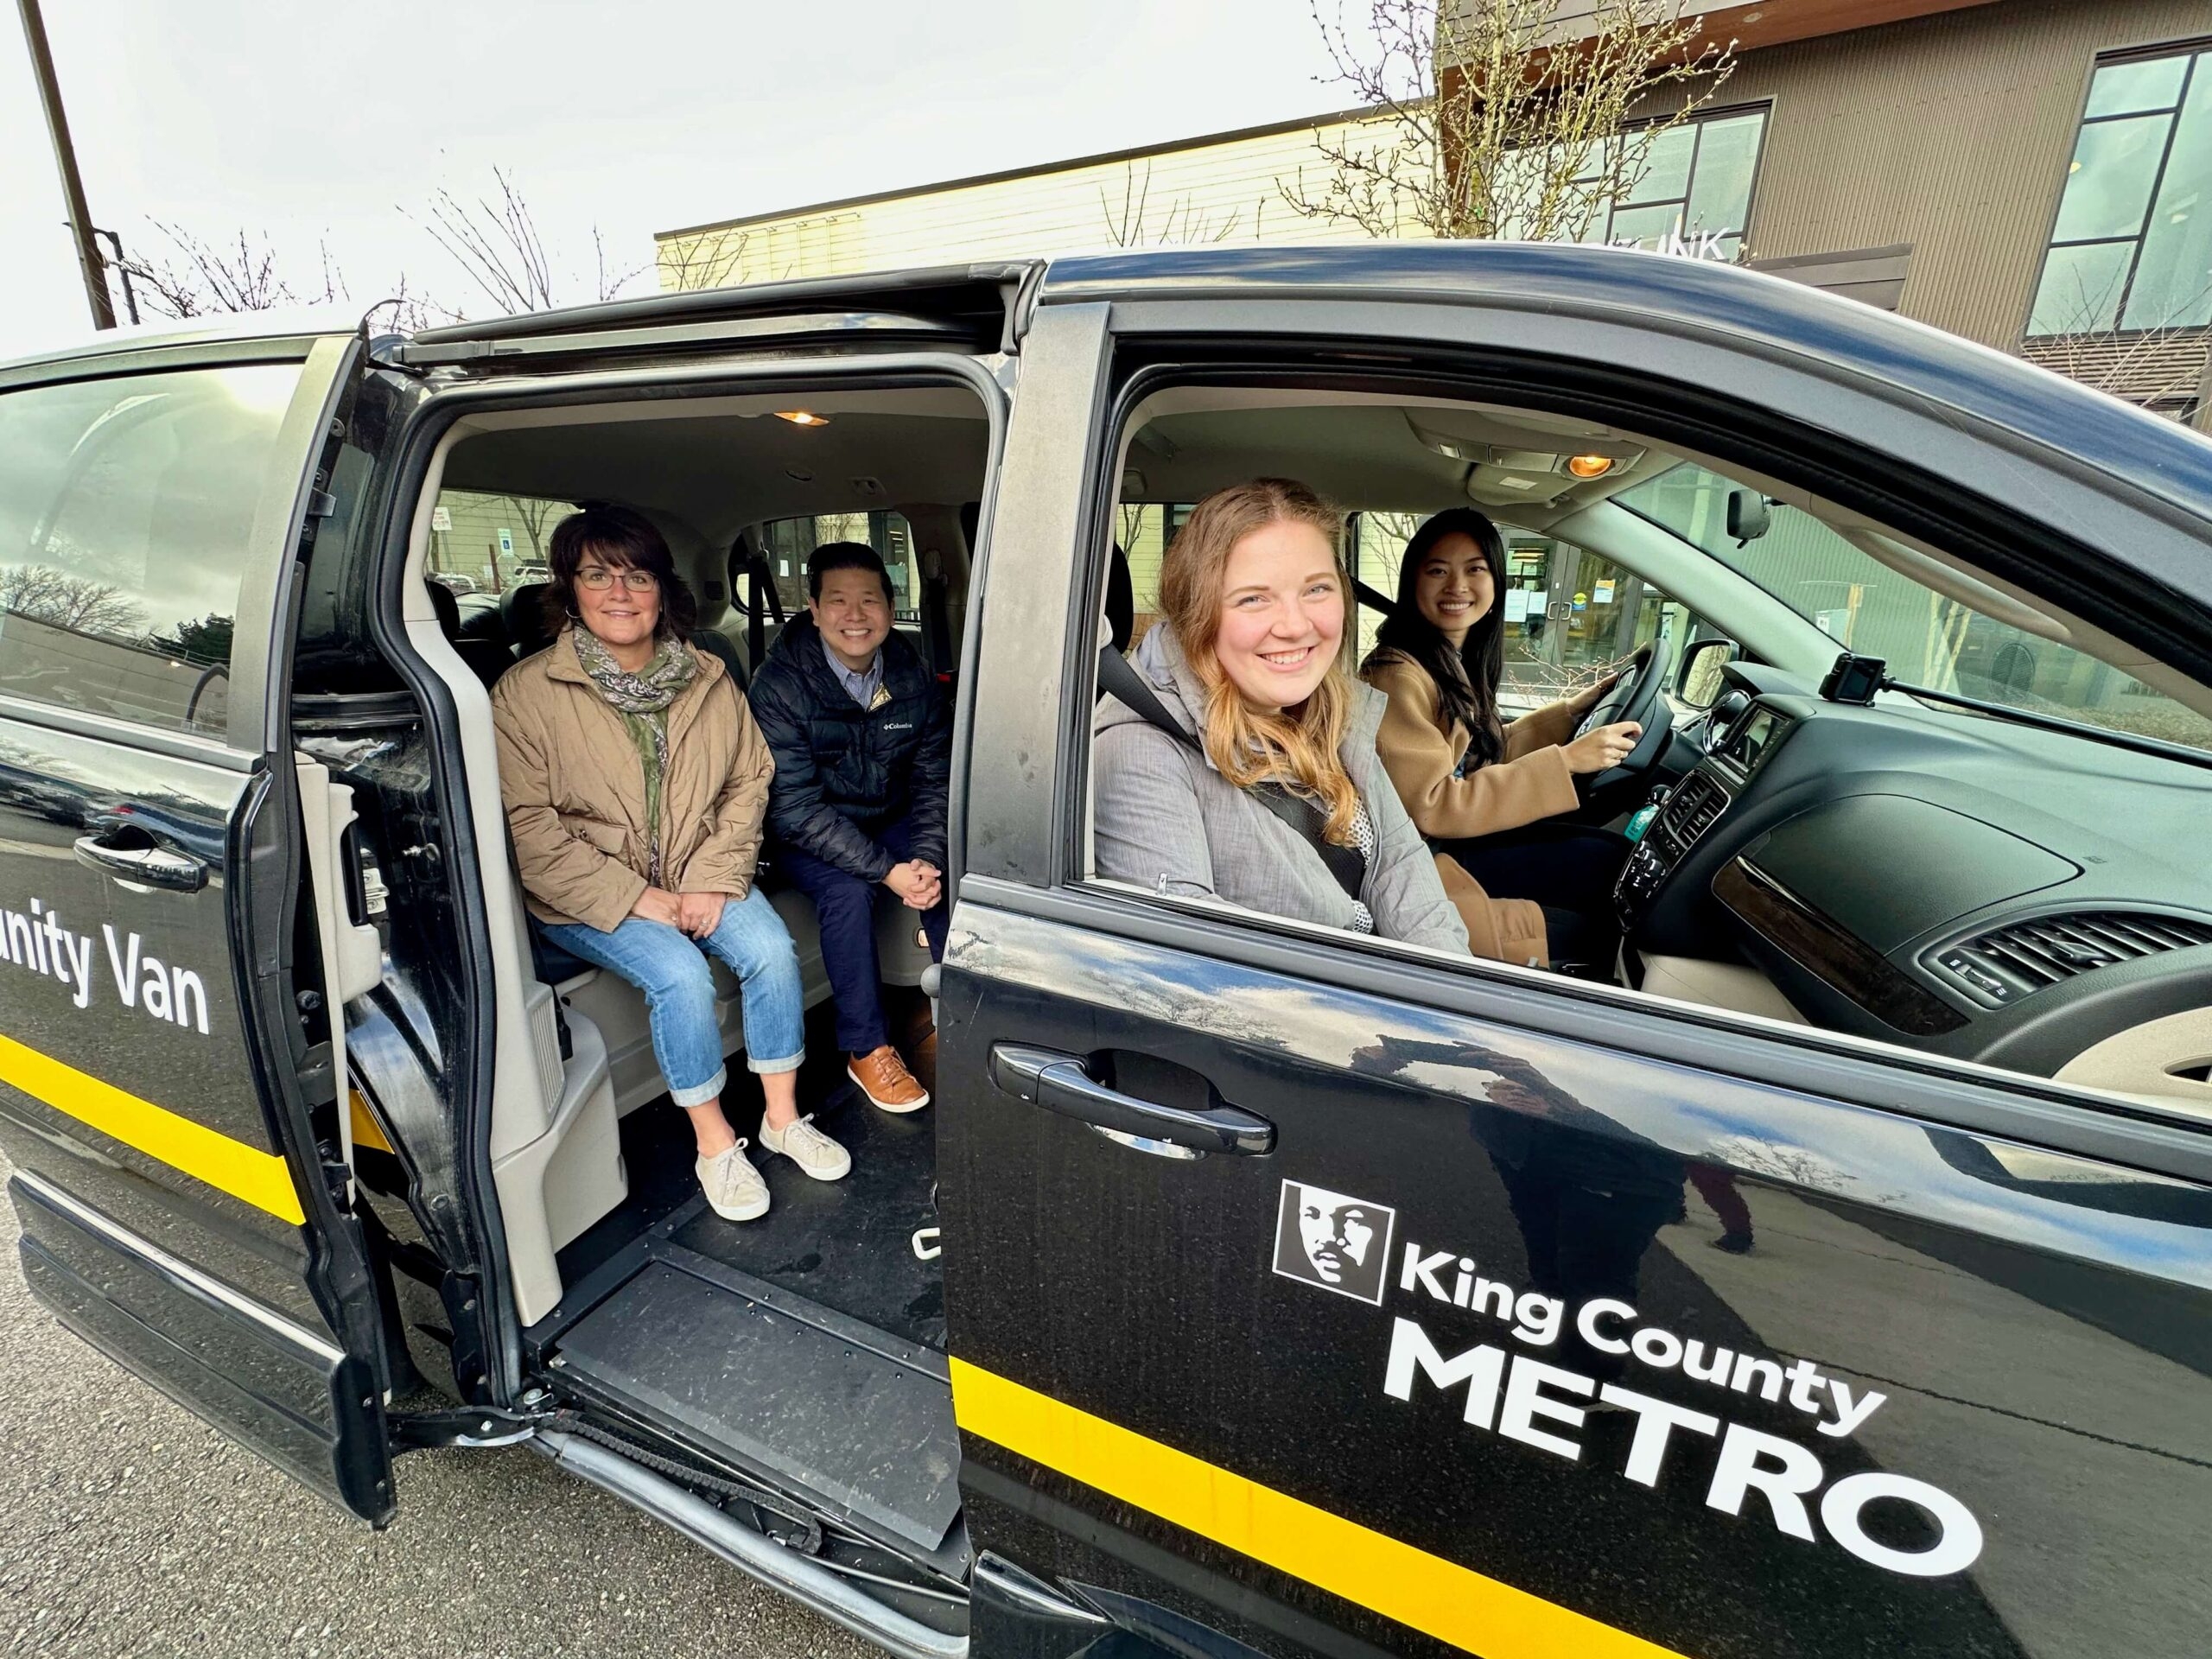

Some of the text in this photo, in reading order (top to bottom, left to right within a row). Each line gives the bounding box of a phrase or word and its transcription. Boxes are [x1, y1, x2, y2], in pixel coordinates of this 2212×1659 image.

[102, 923, 210, 1035] Van
[1400, 1242, 1888, 1438] King County
[1383, 1316, 1984, 1577] METRO
